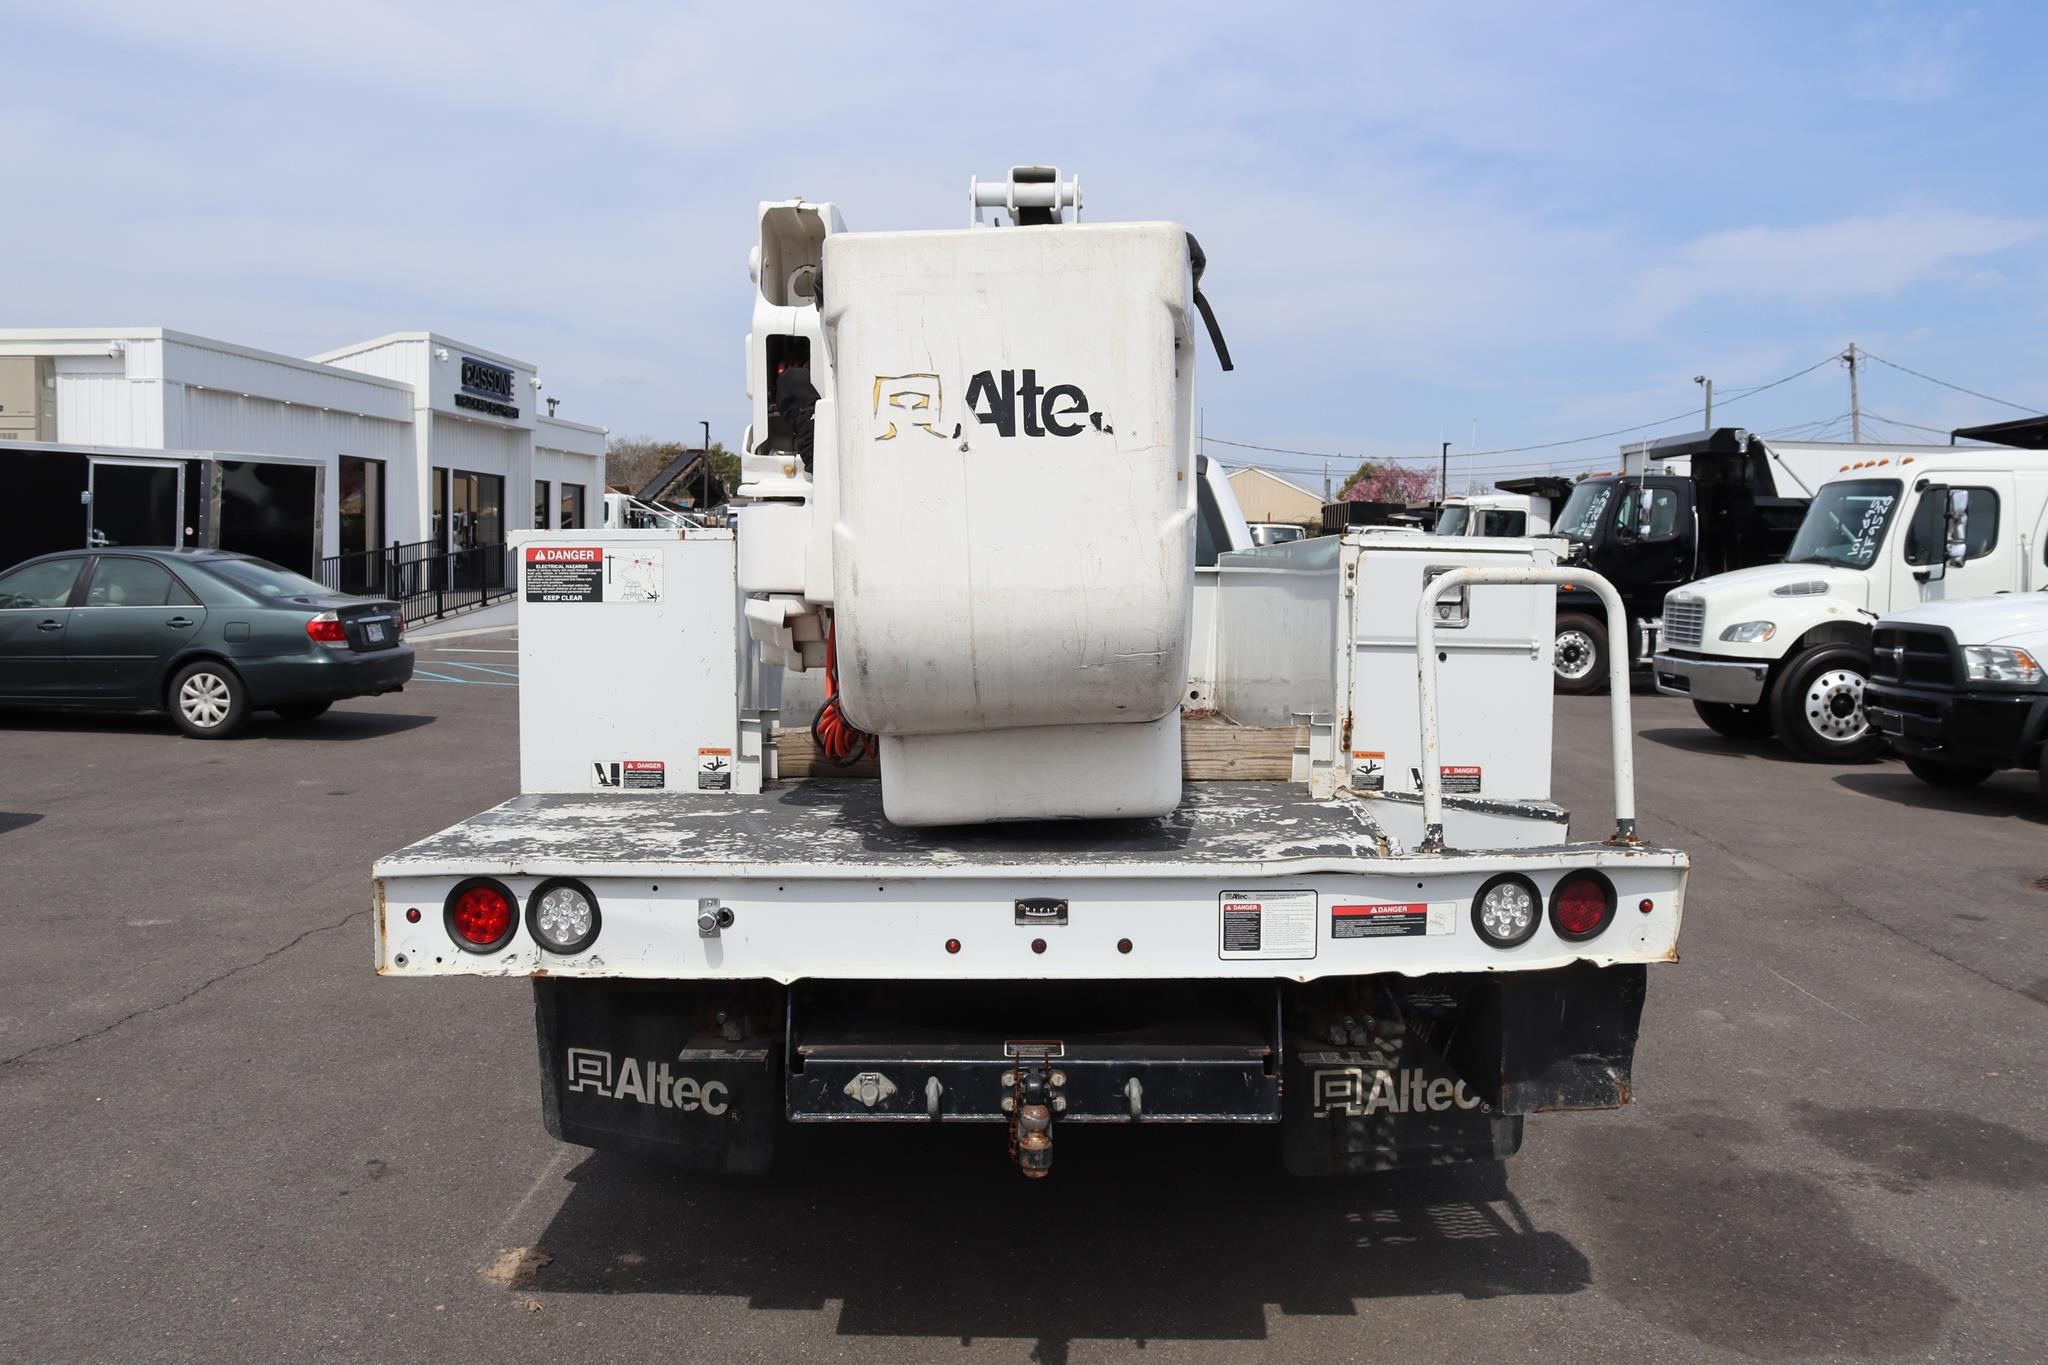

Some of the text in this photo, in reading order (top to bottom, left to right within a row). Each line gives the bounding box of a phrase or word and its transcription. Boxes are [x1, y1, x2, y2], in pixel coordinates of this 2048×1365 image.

[953, 368, 1113, 439] Alte
[547, 550, 594, 560] DANGER
[1377, 906, 1408, 914] DANGER
[612, 1057, 729, 1116] Altec
[1364, 1069, 1481, 1116] Altec
